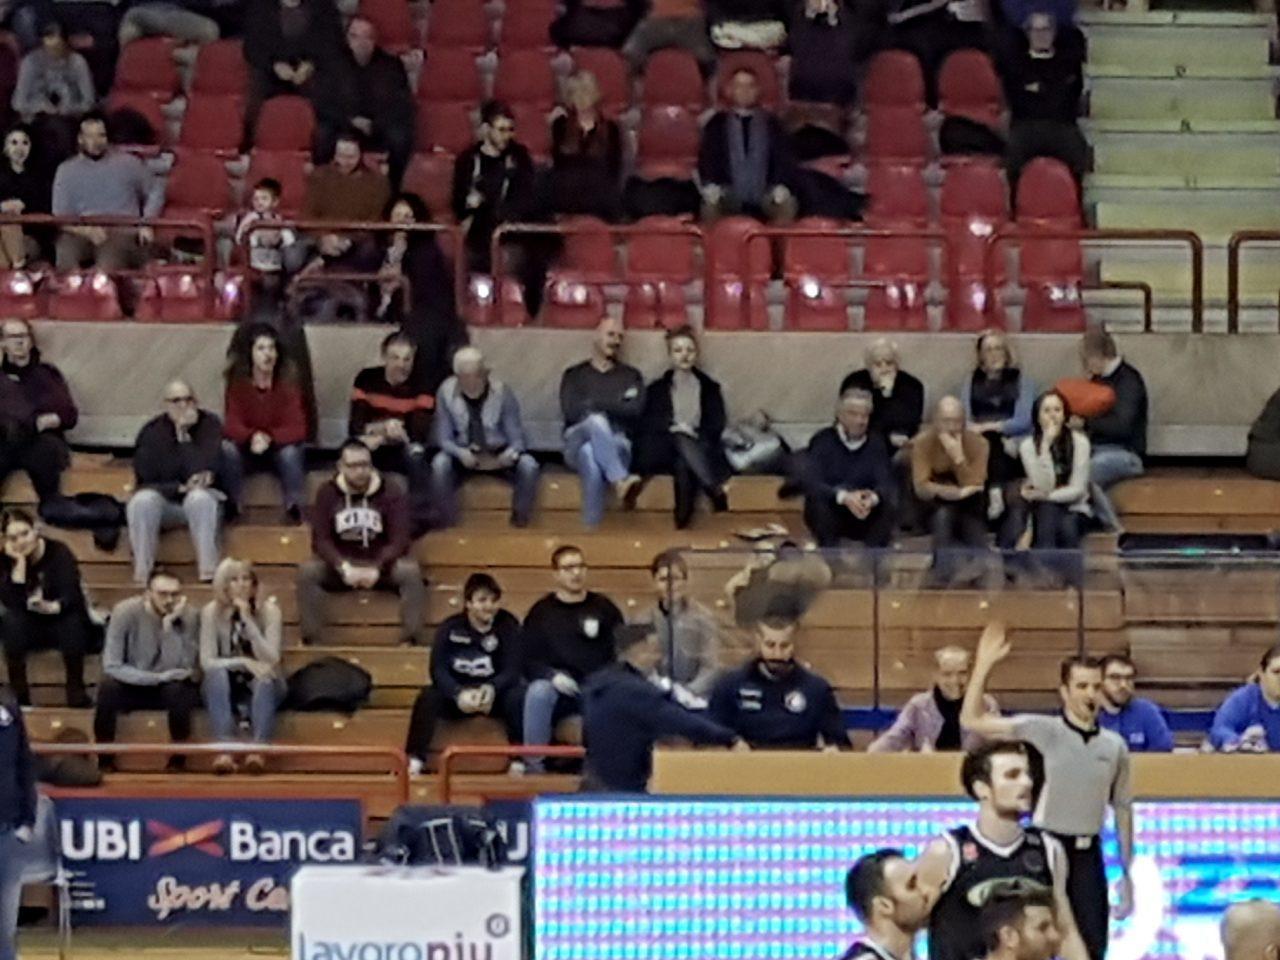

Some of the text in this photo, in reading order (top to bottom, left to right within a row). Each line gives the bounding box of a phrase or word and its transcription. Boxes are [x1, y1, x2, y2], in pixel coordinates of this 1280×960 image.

[60, 819, 355, 861] UBI Banca
[148, 876, 241, 919] Sport
